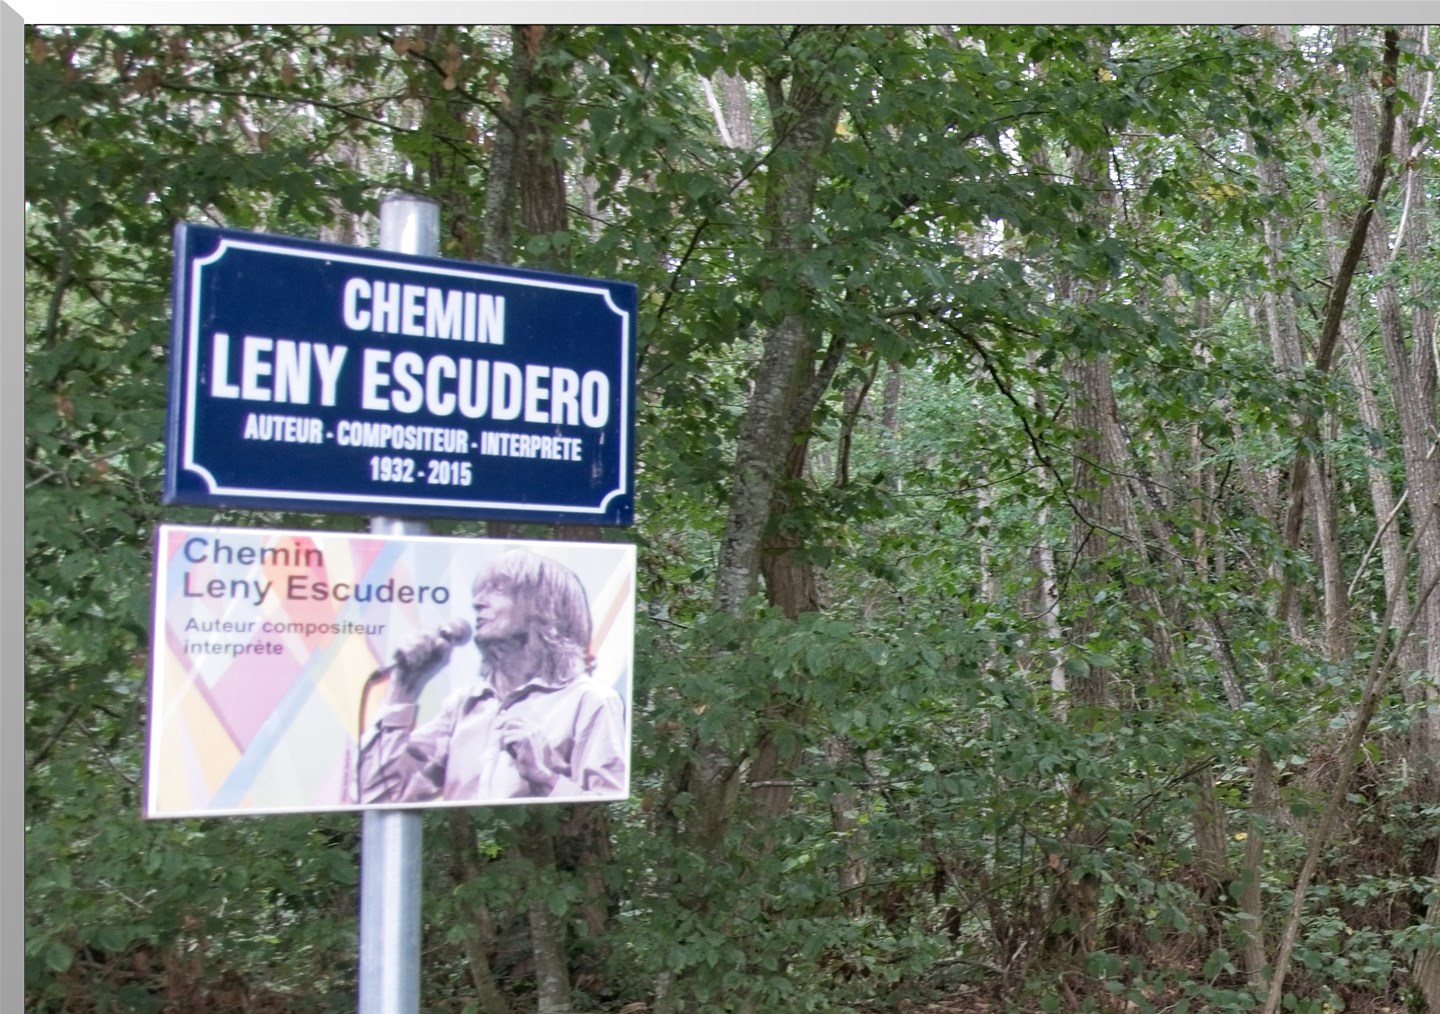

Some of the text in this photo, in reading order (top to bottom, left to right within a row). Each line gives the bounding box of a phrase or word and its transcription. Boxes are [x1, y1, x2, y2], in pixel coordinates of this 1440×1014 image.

[343, 277, 505, 345] CHEMIN
[211, 333, 610, 428] LENY ESCUDERO
[244, 414, 322, 445] AUTEUR
[337, 420, 467, 452] COMPOSITEUR
[370, 457, 414, 483] 1932
[428, 460, 472, 486] 2015
[183, 537, 324, 567] Chemin
[183, 571, 450, 606] Leny Escudero
[185, 617, 386, 640] Auteur compositeur
[183, 639, 284, 658] interprète
